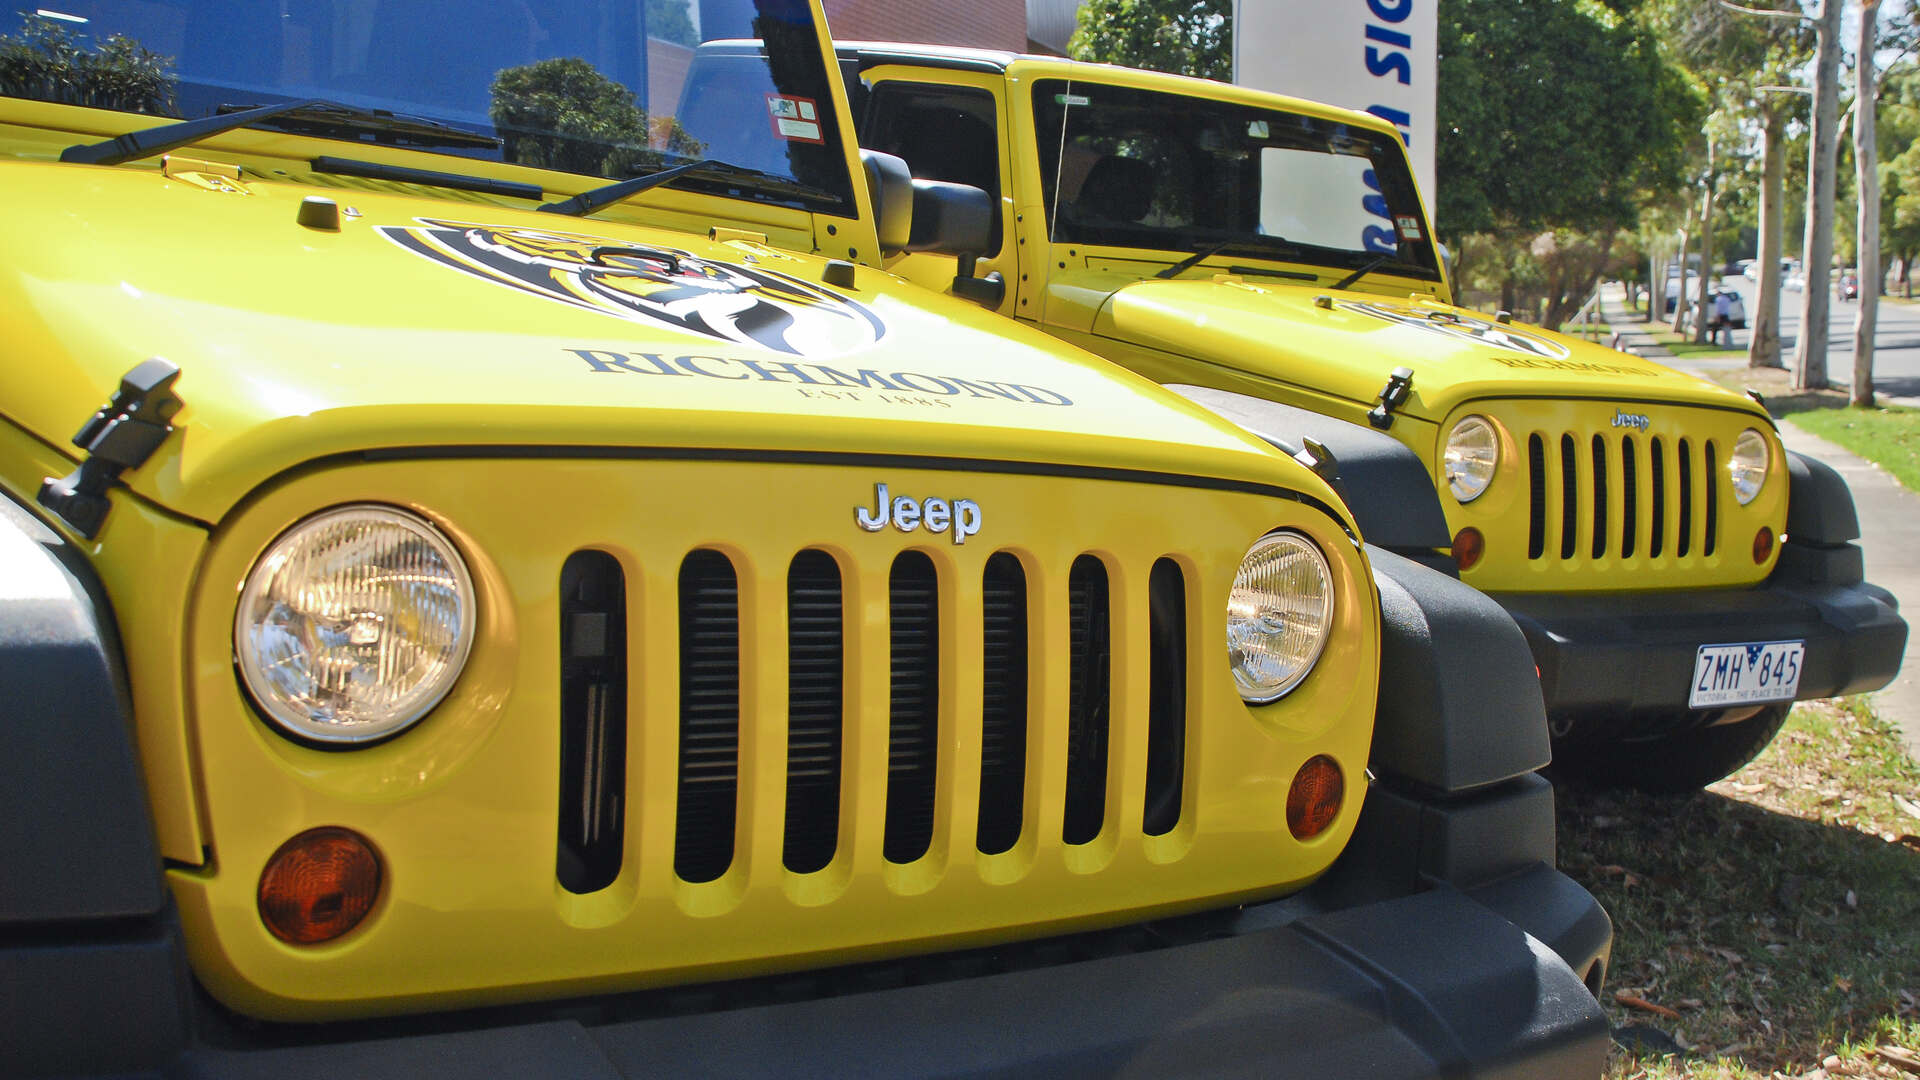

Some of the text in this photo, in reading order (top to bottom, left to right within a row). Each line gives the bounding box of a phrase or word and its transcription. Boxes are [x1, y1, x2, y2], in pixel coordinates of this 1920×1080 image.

[562, 348, 1074, 407] RICHMOND
[1611, 408, 1649, 433] Jeep
[855, 482, 982, 545] Jeep
[1698, 650, 1799, 691] ZMH 845
